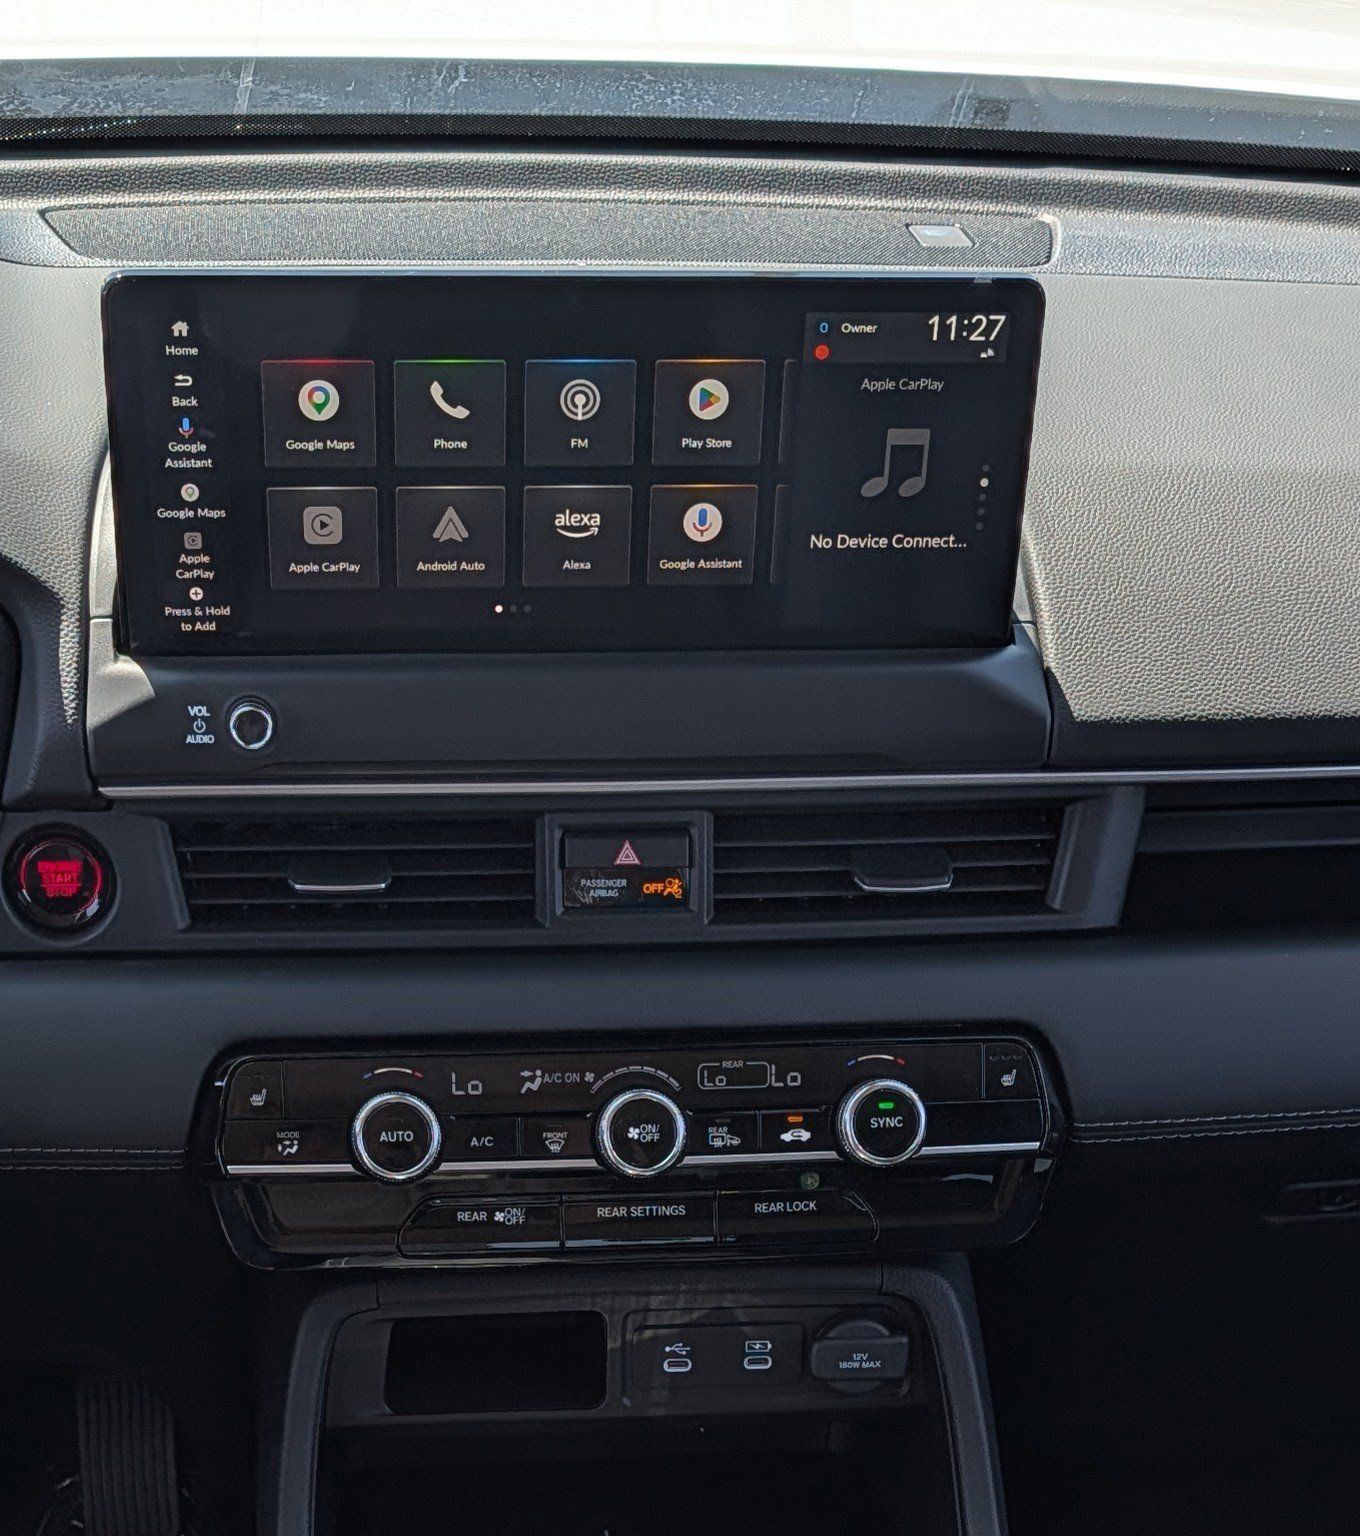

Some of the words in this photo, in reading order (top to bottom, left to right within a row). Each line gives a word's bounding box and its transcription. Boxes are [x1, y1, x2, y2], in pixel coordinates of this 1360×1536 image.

[841, 323, 878, 333] Owner
[928, 314, 1007, 342] 11:27
[165, 345, 199, 356] Home
[860, 378, 896, 392] Apple
[898, 378, 945, 392] CarPlay
[172, 397, 199, 407] Back
[168, 441, 207, 454] Google
[285, 439, 324, 452] Google
[326, 440, 355, 451] Maps
[433, 438, 468, 449] Phone
[570, 438, 589, 448] FM
[681, 437, 704, 450] Play
[706, 437, 732, 448] Store
[164, 457, 213, 468] Assistant
[157, 508, 194, 520] Google
[197, 507, 227, 518] Maps
[554, 509, 601, 527] alexa
[810, 534, 833, 549] No
[836, 534, 888, 549] Device
[892, 533, 967, 548] Connect...
[179, 553, 211, 565] Apple
[562, 559, 591, 570] Alexa
[659, 558, 695, 571] Google
[697, 558, 743, 569] Assistant
[289, 562, 319, 574] Apple
[321, 562, 361, 574] CarPlay
[416, 560, 458, 571] Android
[460, 560, 485, 571] Auto
[175, 569, 215, 580] CarPlay
[164, 607, 192, 617] Press
[194, 607, 203, 617] &
[206, 606, 231, 617] Hold
[181, 622, 192, 631] to
[194, 621, 216, 631] Add
[187, 705, 211, 717] VOL
[185, 734, 215, 744] AUDIO
[580, 879, 627, 888] PASSENGER
[643, 883, 665, 894] OFF
[589, 889, 619, 897] AIRBAG
[542, 1073, 562, 1083] A/C
[564, 1073, 580, 1083] ON
[870, 1116, 903, 1129] SYNC
[640, 1124, 660, 1133] ON/
[379, 1130, 414, 1144] AUTO
[542, 1131, 568, 1139] FRONT
[640, 1133, 660, 1142] OFF
[470, 1136, 494, 1147] A/C
[504, 1207, 526, 1216] ON/
[597, 1207, 628, 1218] REAR
[629, 1205, 686, 1217] SETTINGS
[754, 1201, 784, 1213] REAR
[786, 1200, 817, 1212] LOCK
[457, 1211, 488, 1222] REAR
[504, 1216, 525, 1226] OFF
